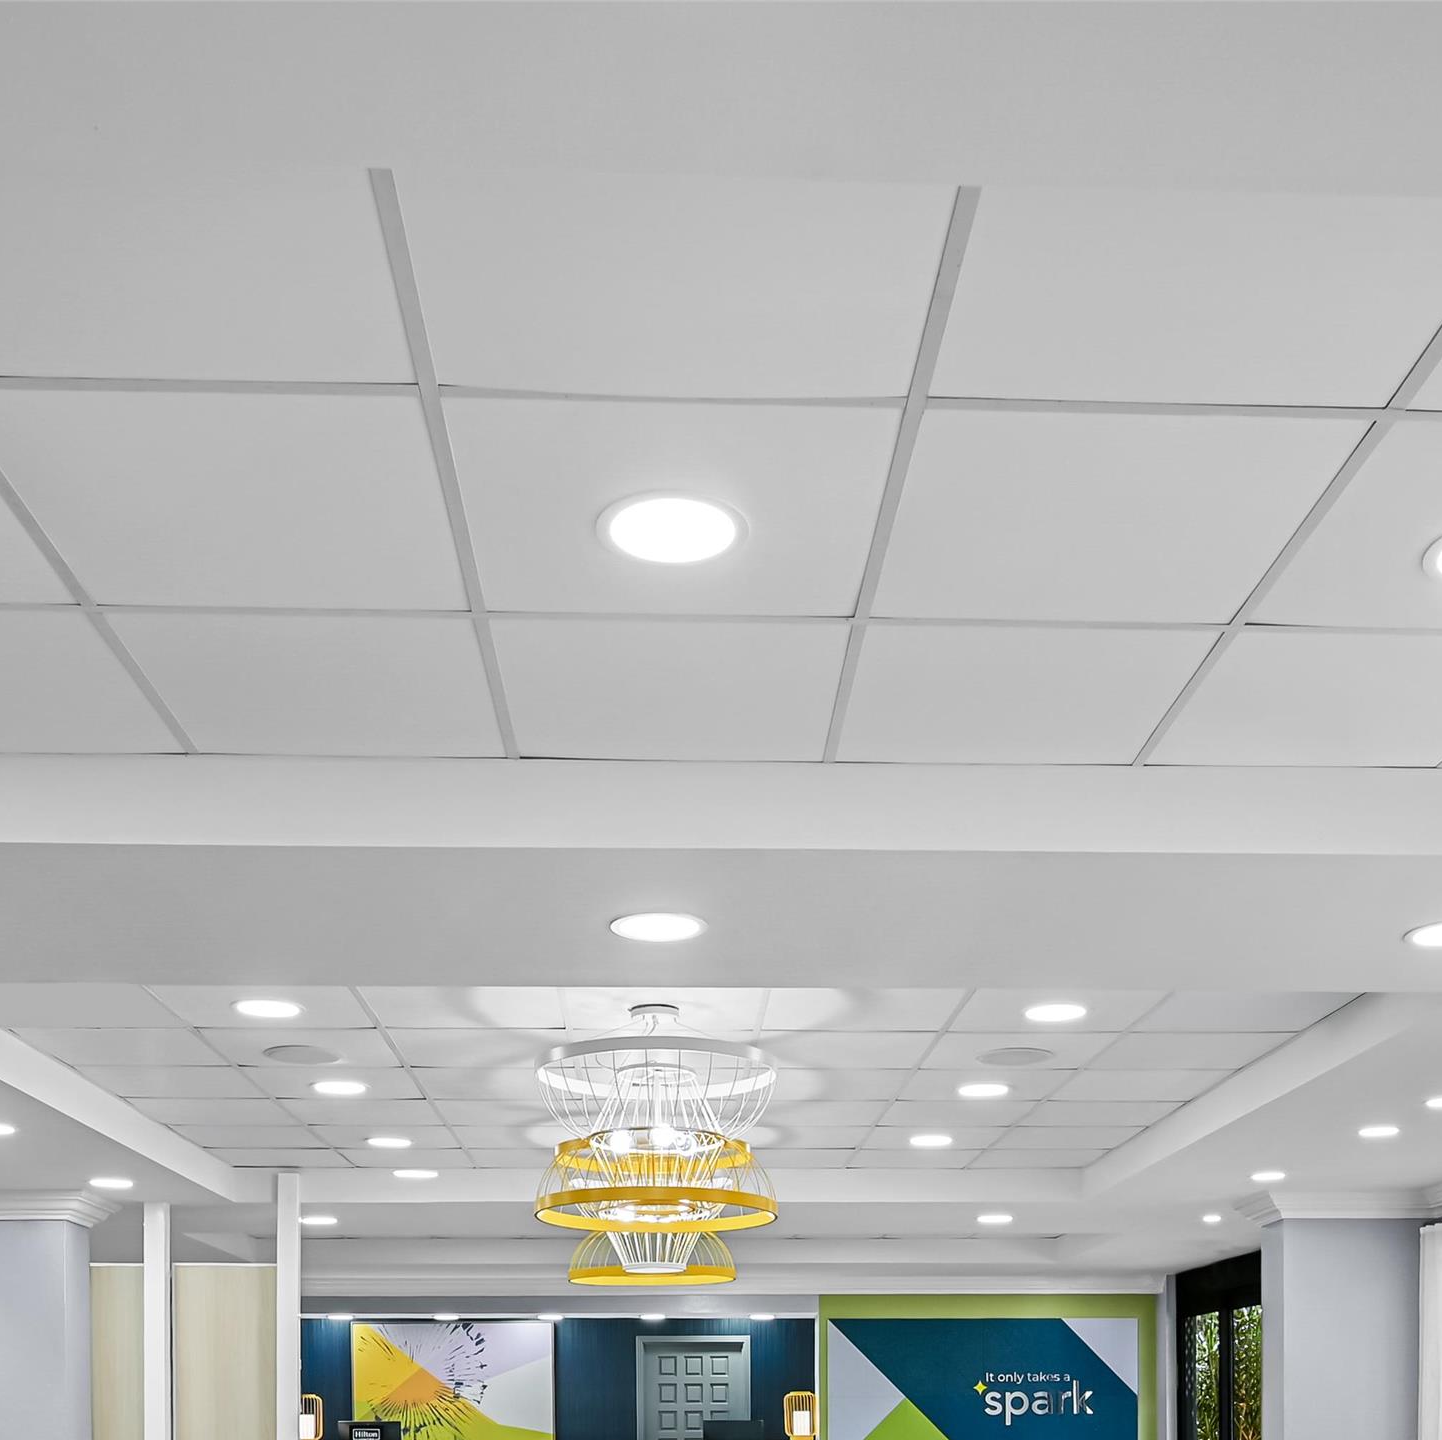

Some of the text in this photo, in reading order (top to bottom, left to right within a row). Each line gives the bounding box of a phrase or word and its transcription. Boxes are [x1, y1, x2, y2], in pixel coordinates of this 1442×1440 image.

[985, 1371, 1071, 1385] It only takes a
[984, 1380, 1093, 1426] spark
